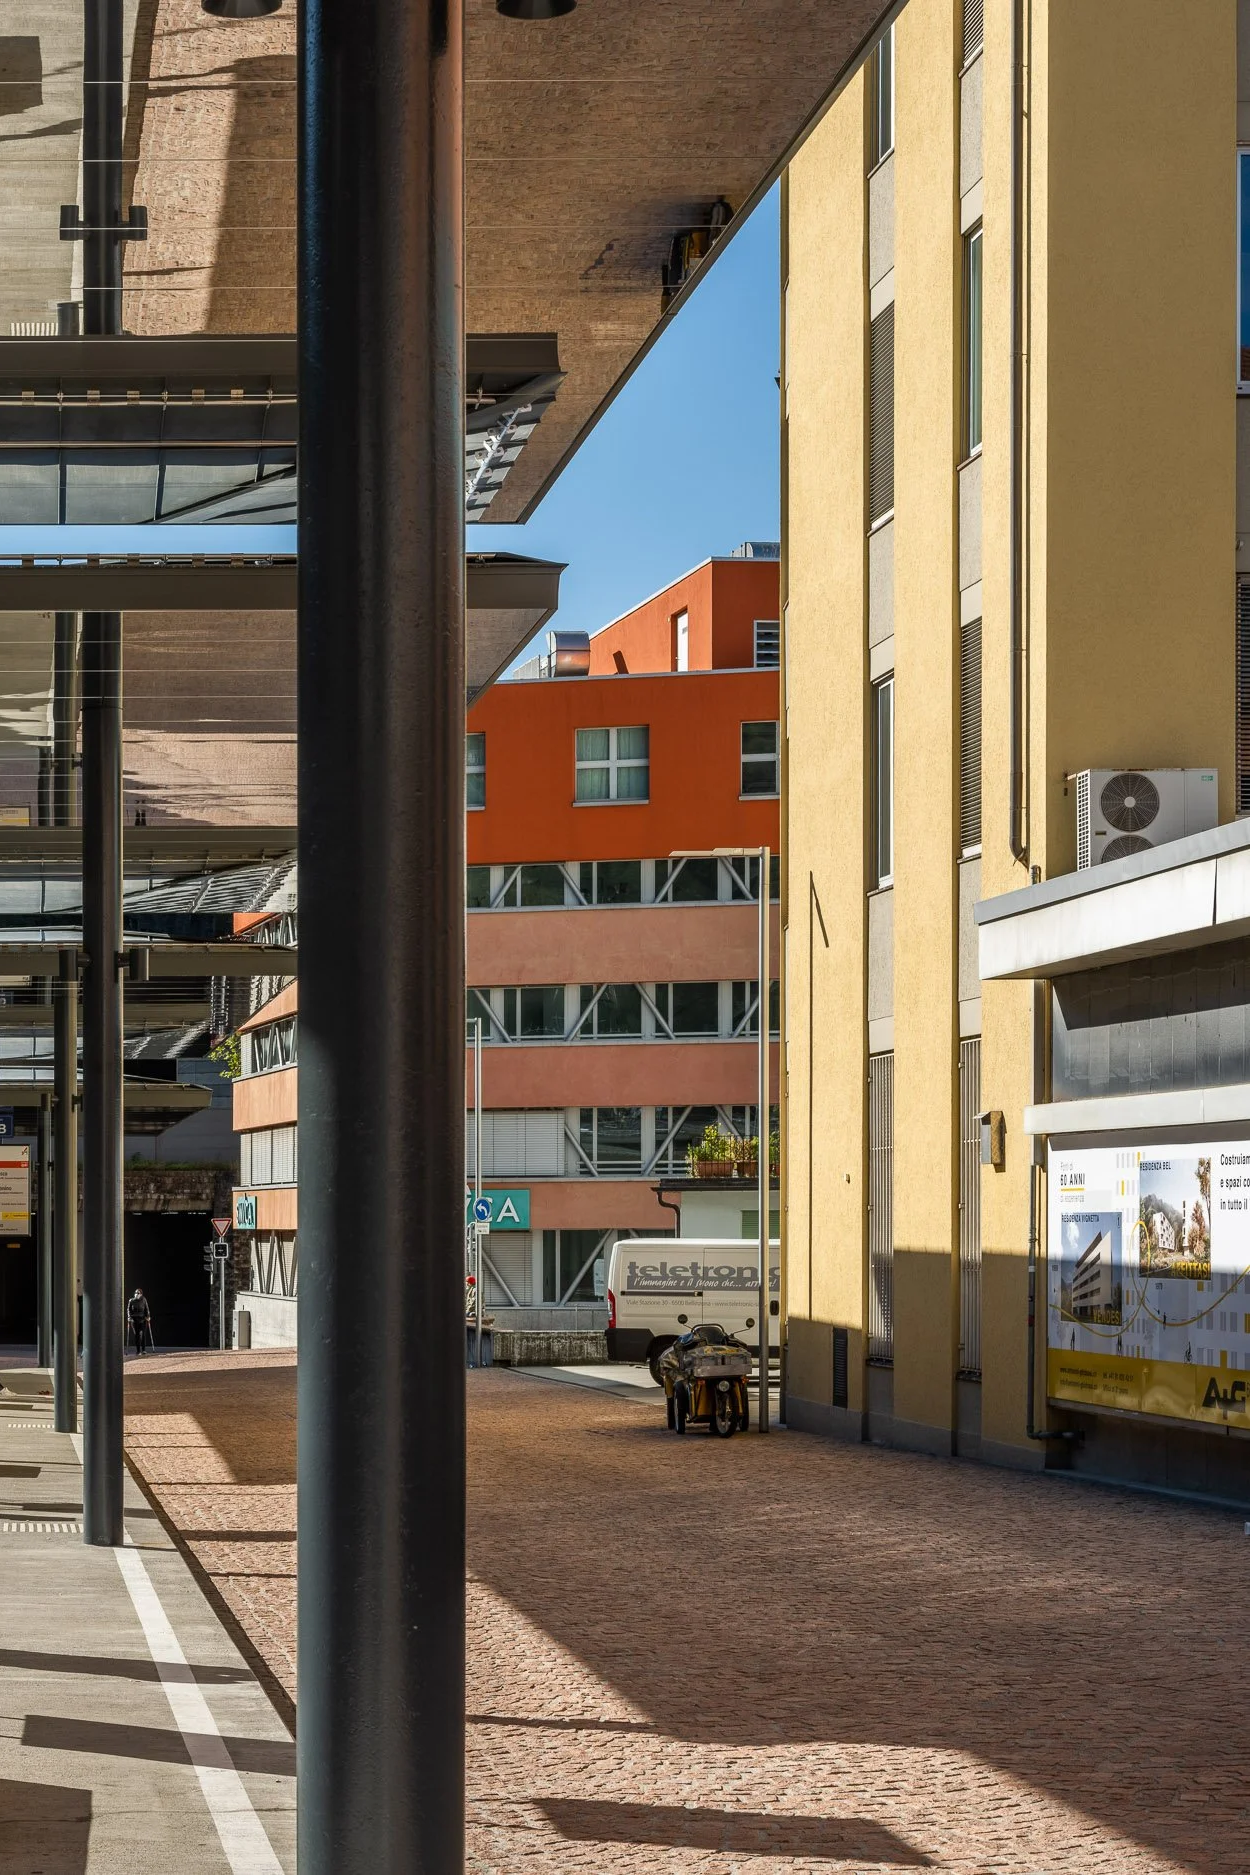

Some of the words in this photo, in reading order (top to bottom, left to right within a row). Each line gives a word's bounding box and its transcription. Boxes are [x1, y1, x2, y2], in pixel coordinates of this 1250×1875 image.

[1070, 1173, 1085, 1185] ANNI
[1220, 1179, 1224, 1188] e
[1225, 1176, 1242, 1190] spazi
[1220, 1199, 1226, 1210] in
[1227, 1199, 1243, 1210] tutto
[1243, 1198, 1248, 1210] il
[1093, 1309, 1121, 1324] VENDESI
